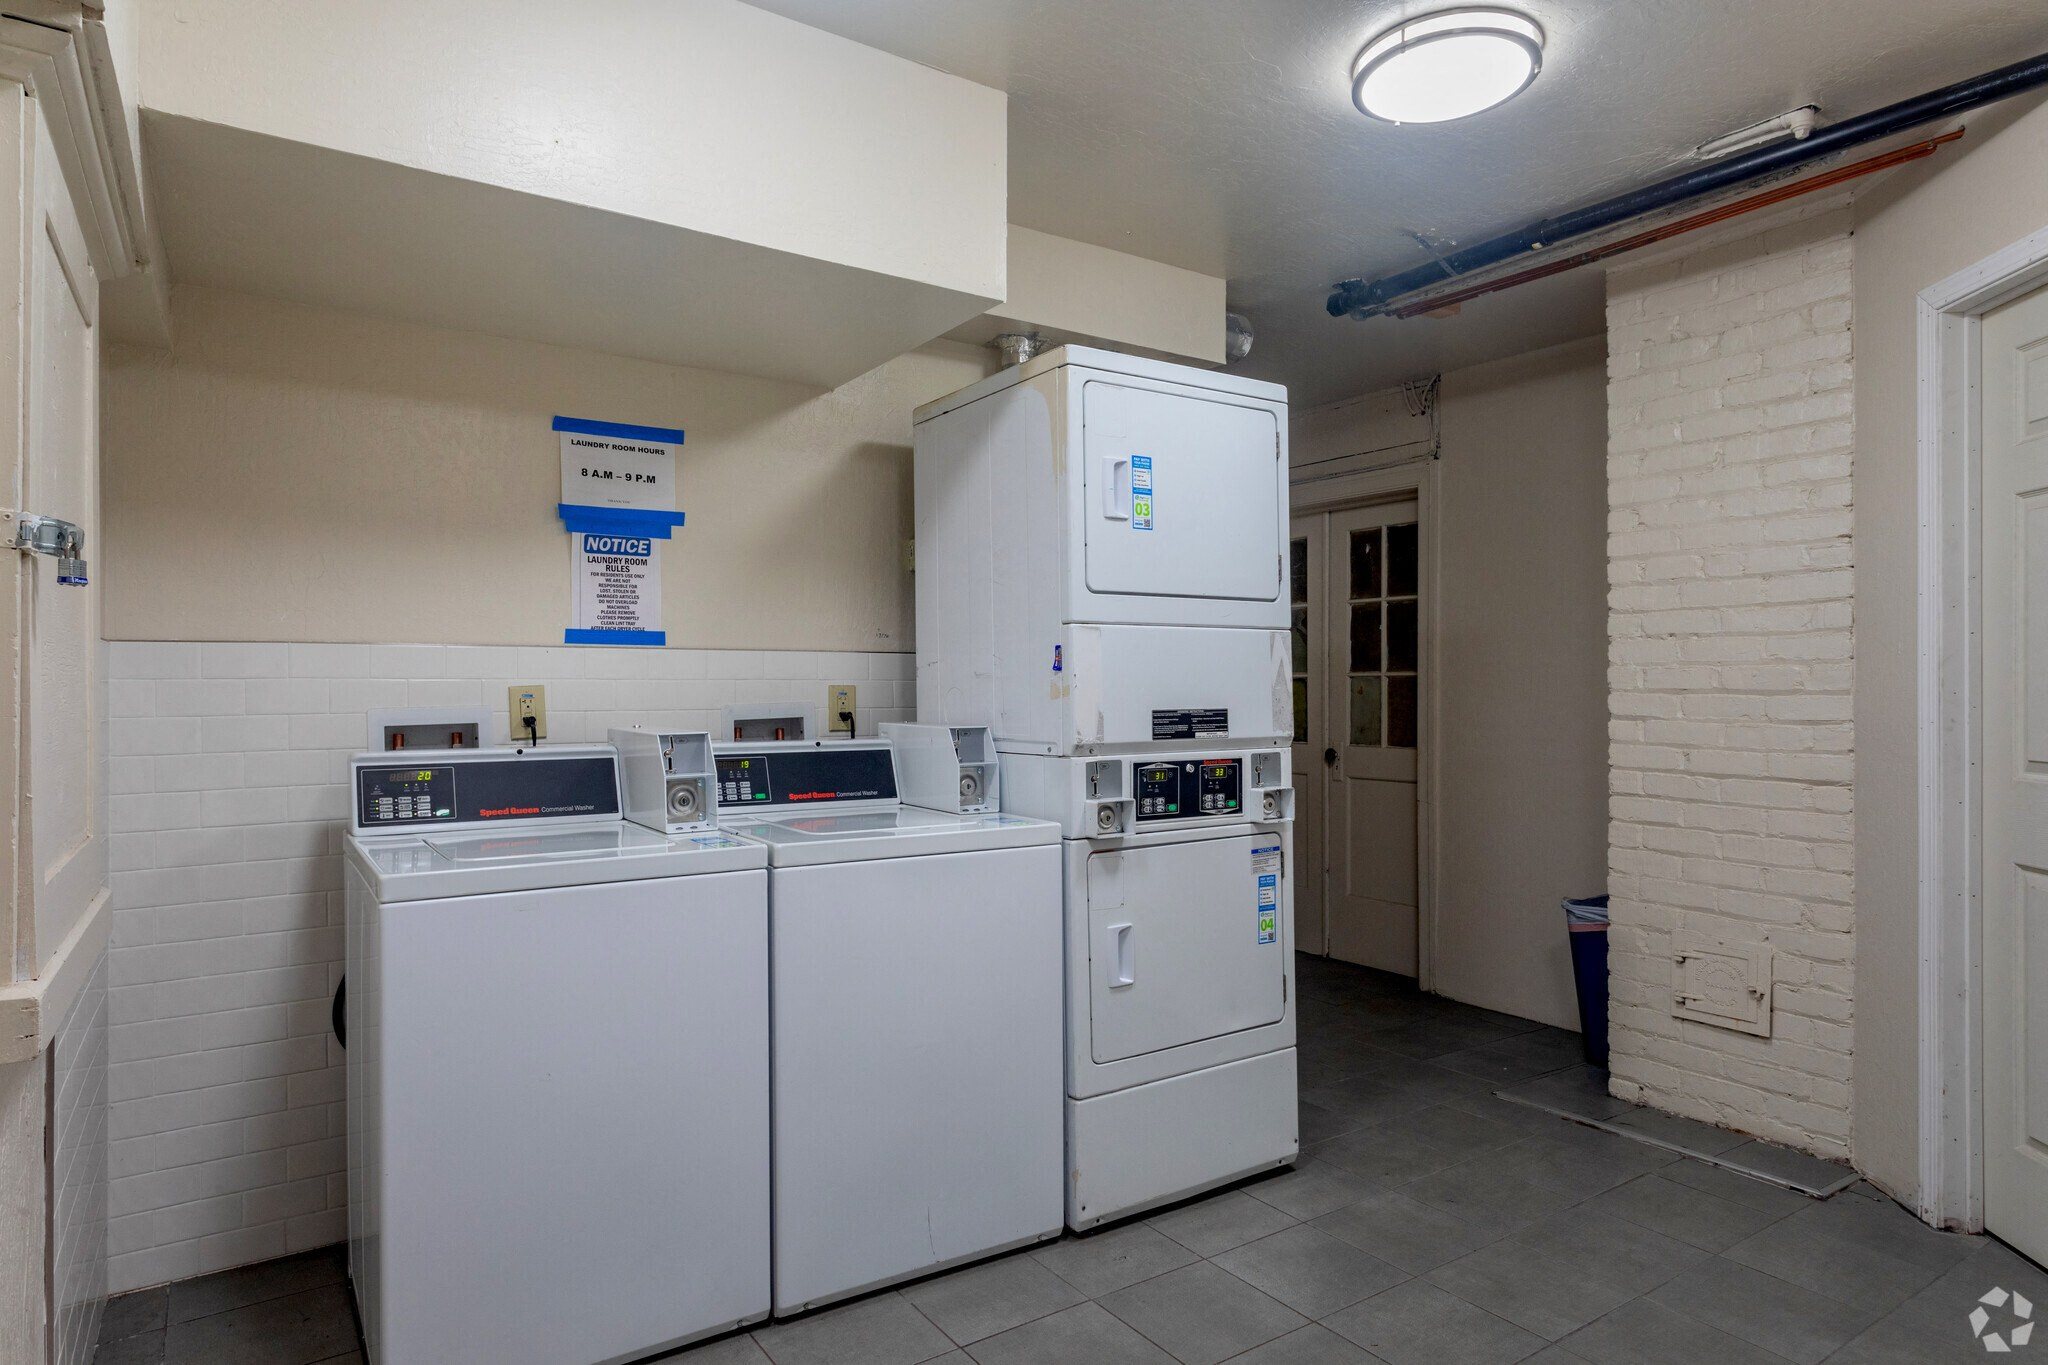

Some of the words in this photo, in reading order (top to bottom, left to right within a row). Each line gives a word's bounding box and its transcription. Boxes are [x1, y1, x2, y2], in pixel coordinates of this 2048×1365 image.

[2008, 63, 2048, 80] CHAR
[570, 439, 610, 450] LAUNDRY
[612, 444, 636, 453] ROOM
[637, 446, 665, 456] HOURS
[581, 468, 588, 476] 8
[592, 469, 613, 479] A.M
[625, 473, 632, 481] 9
[635, 474, 656, 484] P.M
[1134, 502, 1150, 517] 03
[586, 536, 649, 553] NOTICE
[587, 556, 624, 565] LAUNDRY
[624, 557, 648, 566] ROOM
[605, 564, 630, 573] RULES
[741, 760, 750, 768] 19
[417, 770, 432, 781] 20
[1155, 772, 1165, 780] 31
[1215, 768, 1224, 777] 33
[788, 792, 812, 800] Speed
[812, 791, 836, 799] Queen
[480, 808, 509, 817] Speed
[510, 807, 539, 815] Queen
[1261, 918, 1274, 931] 04
